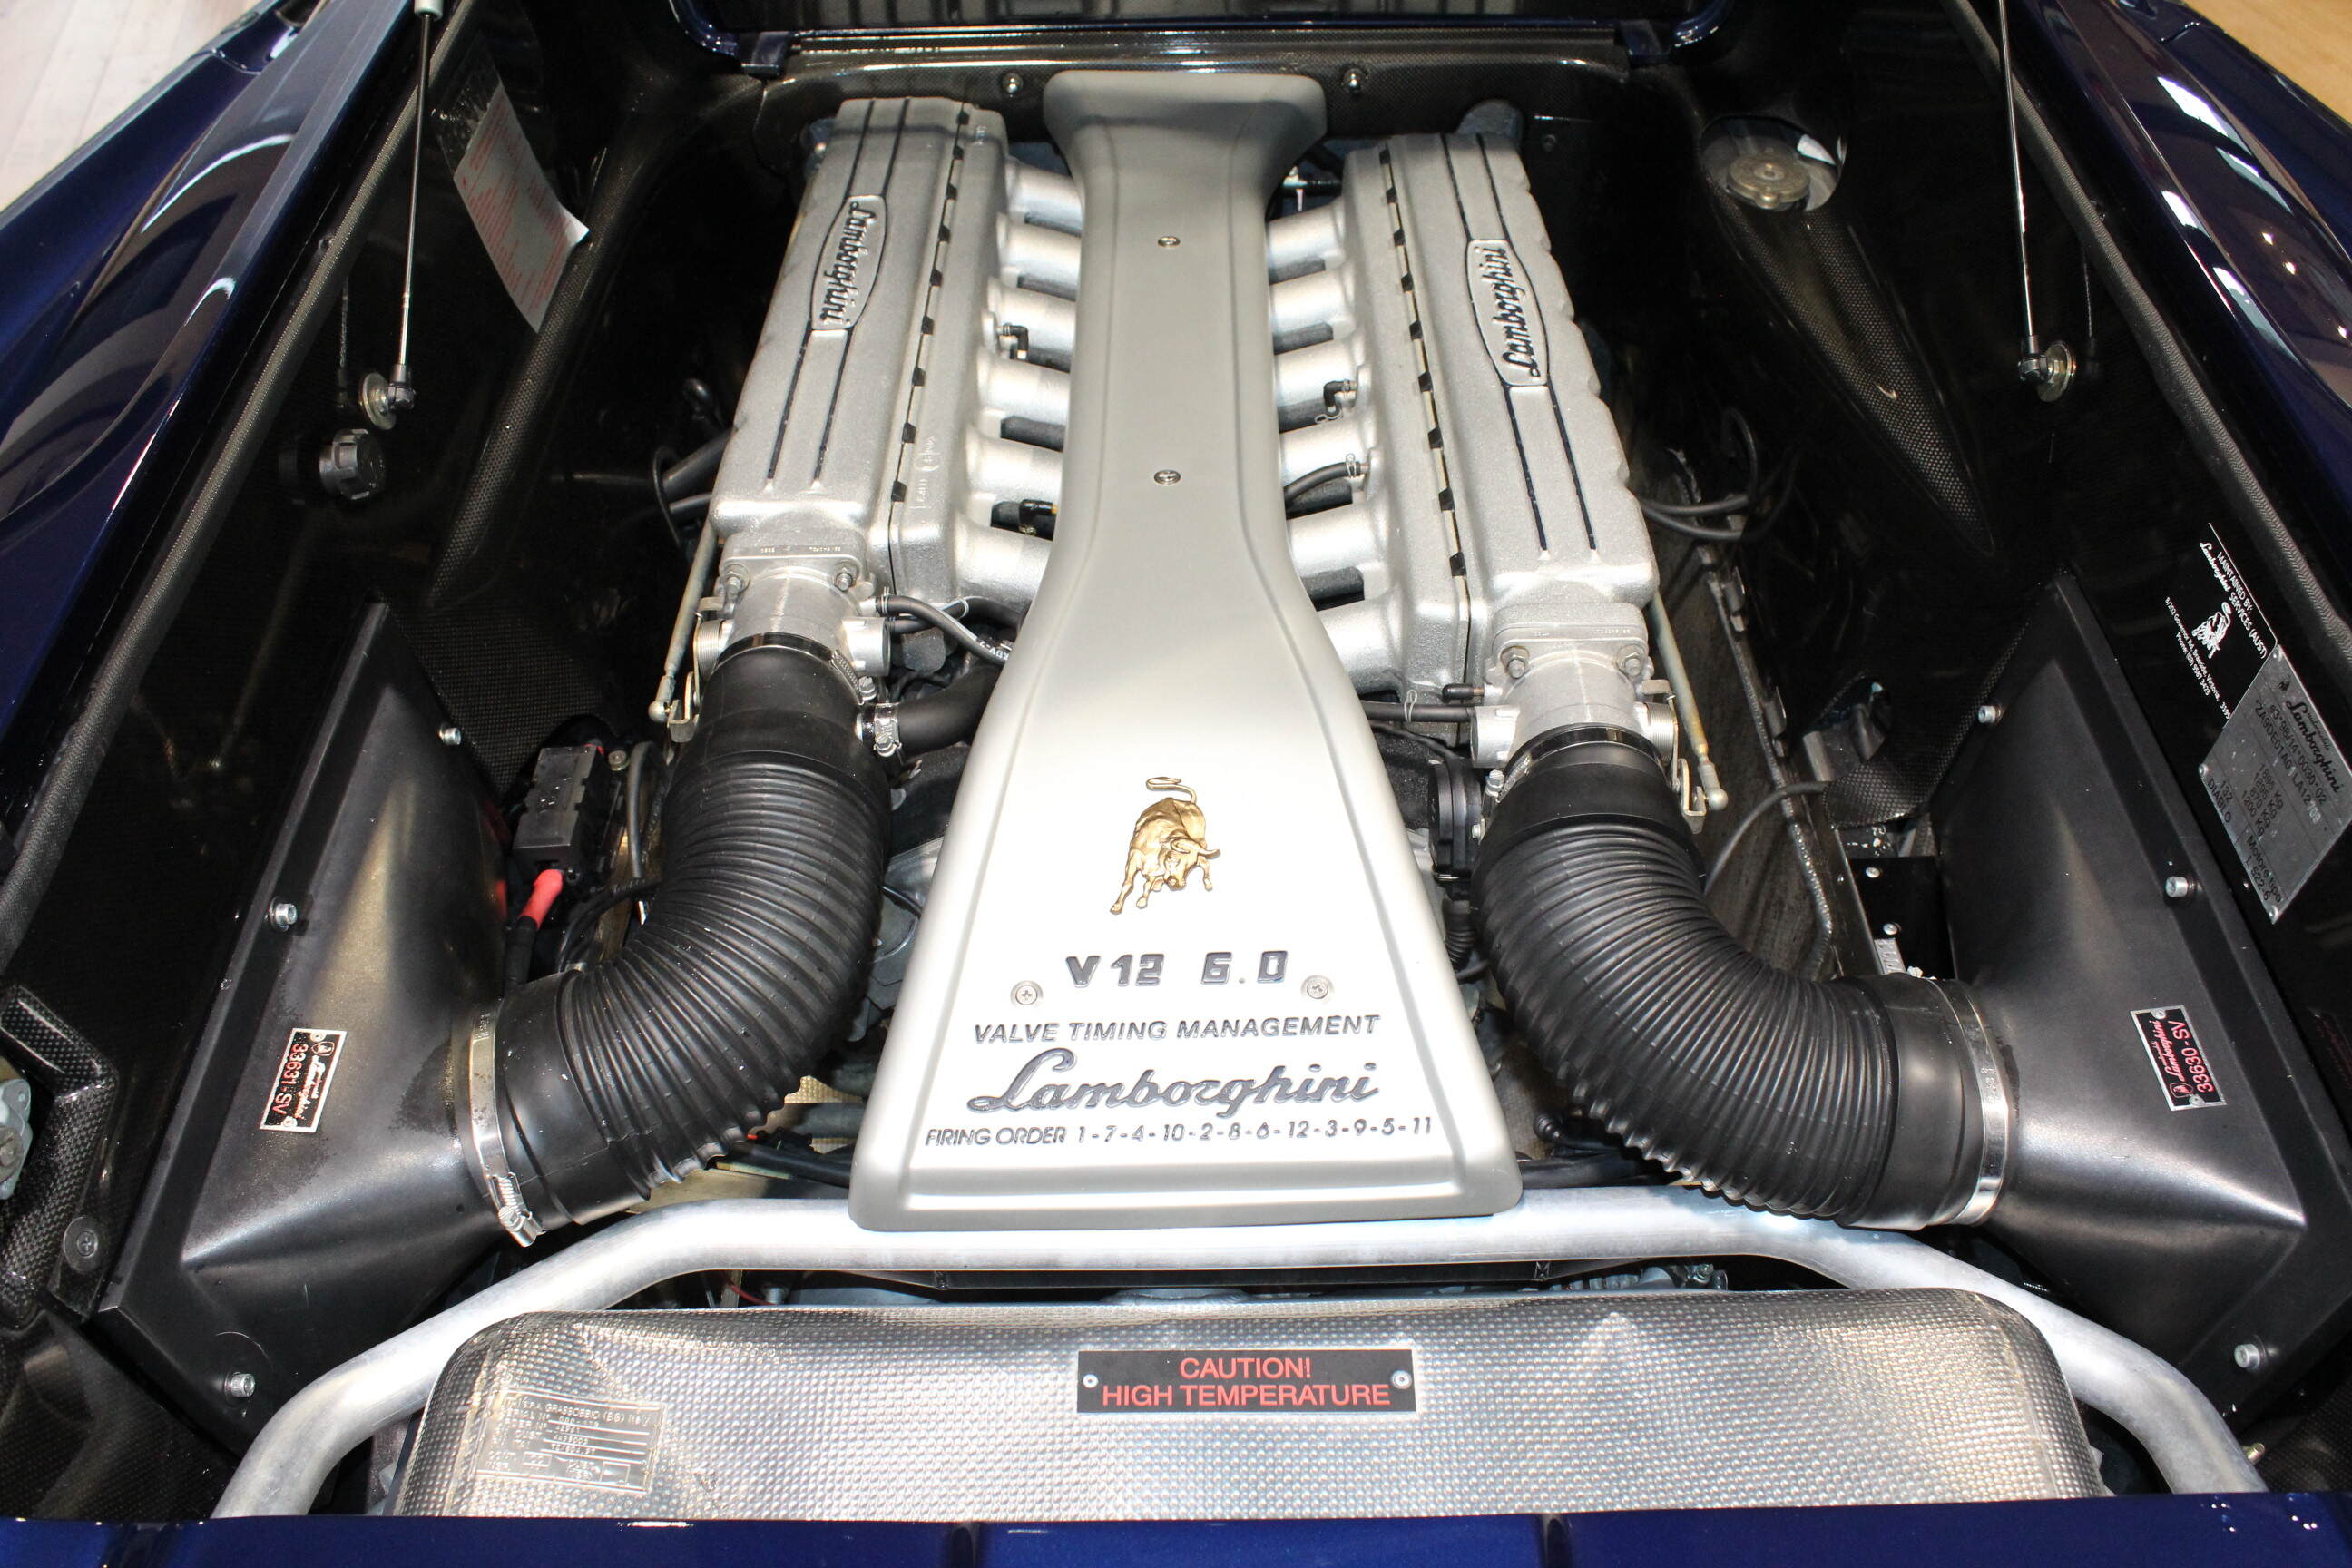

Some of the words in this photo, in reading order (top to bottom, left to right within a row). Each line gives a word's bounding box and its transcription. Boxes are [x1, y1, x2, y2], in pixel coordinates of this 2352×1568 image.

[820, 201, 876, 323] Lamborghini
[1475, 247, 1541, 377] Lamborghini
[2217, 551, 2245, 600] MAINTAINED
[2200, 542, 2231, 592] Lamborghini
[2229, 592, 2251, 632] SERVICES
[2249, 628, 2269, 659] (AUST)
[2174, 613, 2189, 641] Governor
[2286, 700, 2341, 793] Lamborghini
[2209, 778, 2230, 823] DIABLO
[2248, 835, 2269, 878] Motore
[1065, 953, 1164, 988] V12
[1200, 950, 1288, 985] 6.0
[975, 1023, 1060, 1044] VALVE
[1069, 1020, 1168, 1042] TIMING
[1177, 1014, 1380, 1039] MANAGEMENT
[2148, 1020, 2185, 1082] Lamborghini
[966, 1047, 1380, 1119] Lamborghini
[925, 1128, 992, 1146] FIRING
[995, 1126, 1067, 1145] ORDER
[1180, 1357, 1311, 1379] CAUTION!
[1102, 1385, 1173, 1406] HIGH
[1180, 1384, 1391, 1406] TEMPERATURE
